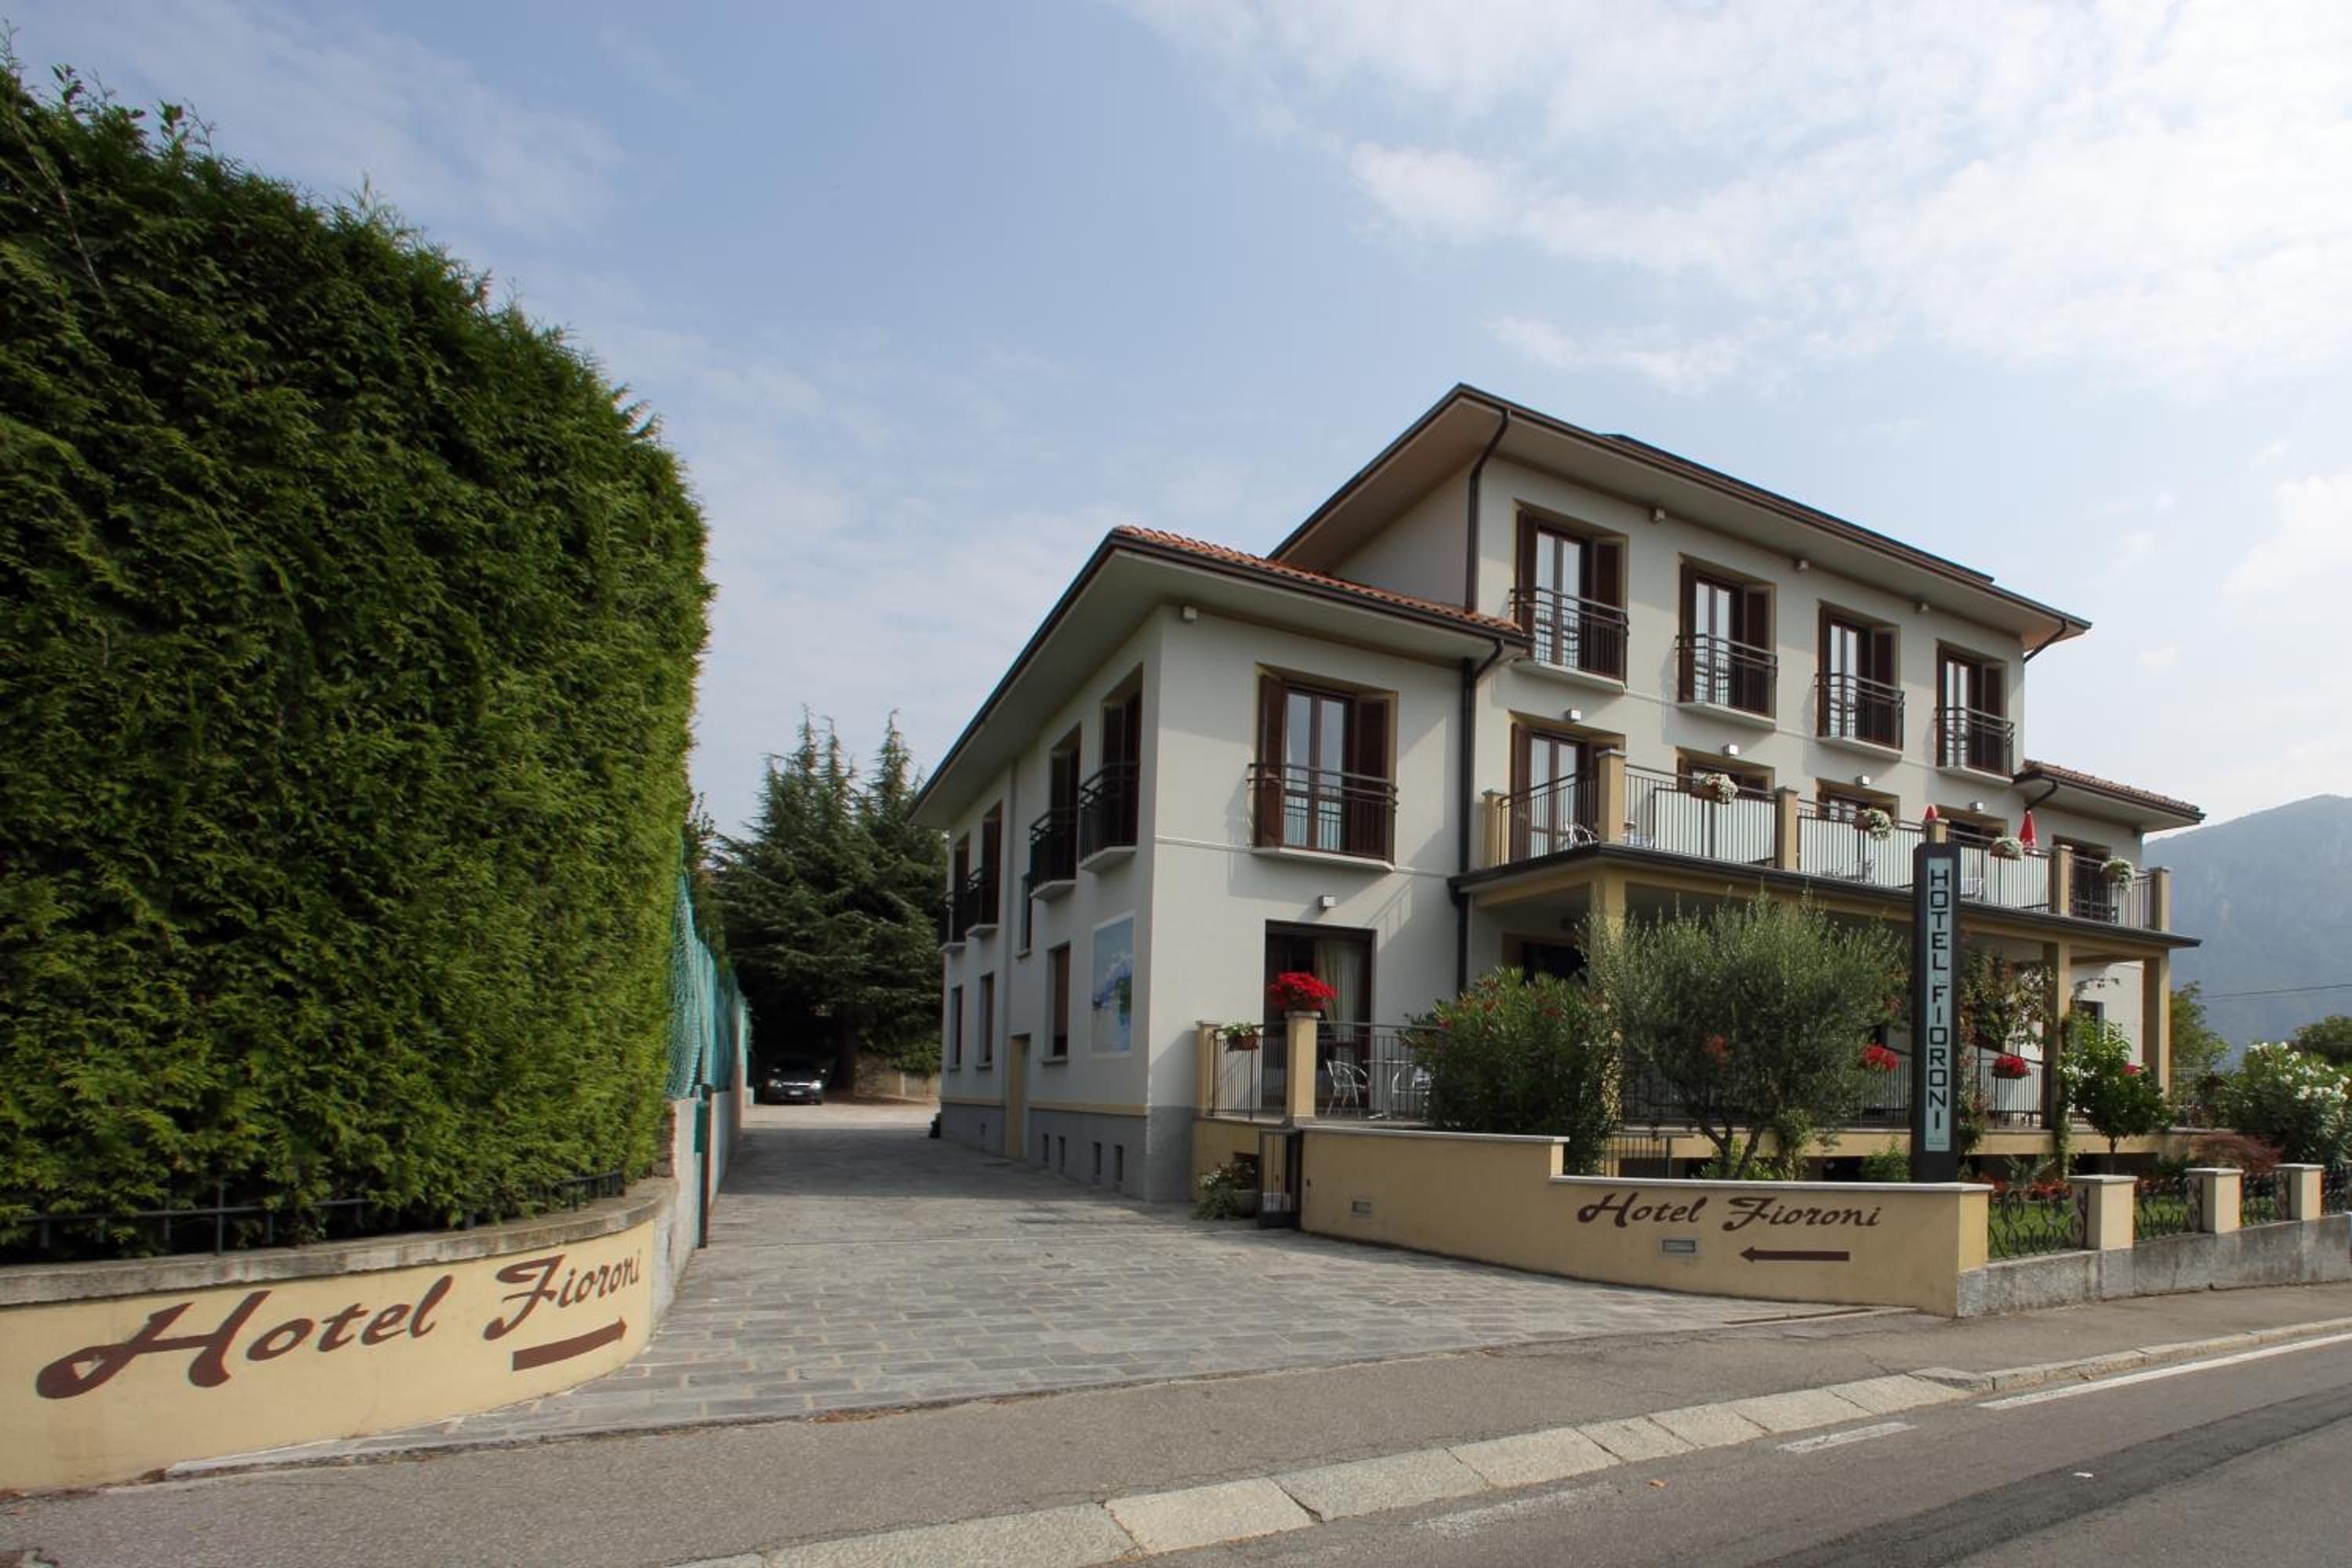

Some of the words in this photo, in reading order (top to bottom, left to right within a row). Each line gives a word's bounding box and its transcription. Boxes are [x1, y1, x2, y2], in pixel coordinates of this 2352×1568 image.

[1930, 869, 1948, 971] HOTEL
[1929, 985, 1948, 1130] FIORONI
[1577, 1192, 1708, 1229] Hotel
[1722, 1196, 1881, 1232] Fioroni
[35, 1275, 453, 1399] Hotel
[484, 1247, 641, 1341] Fioroni
